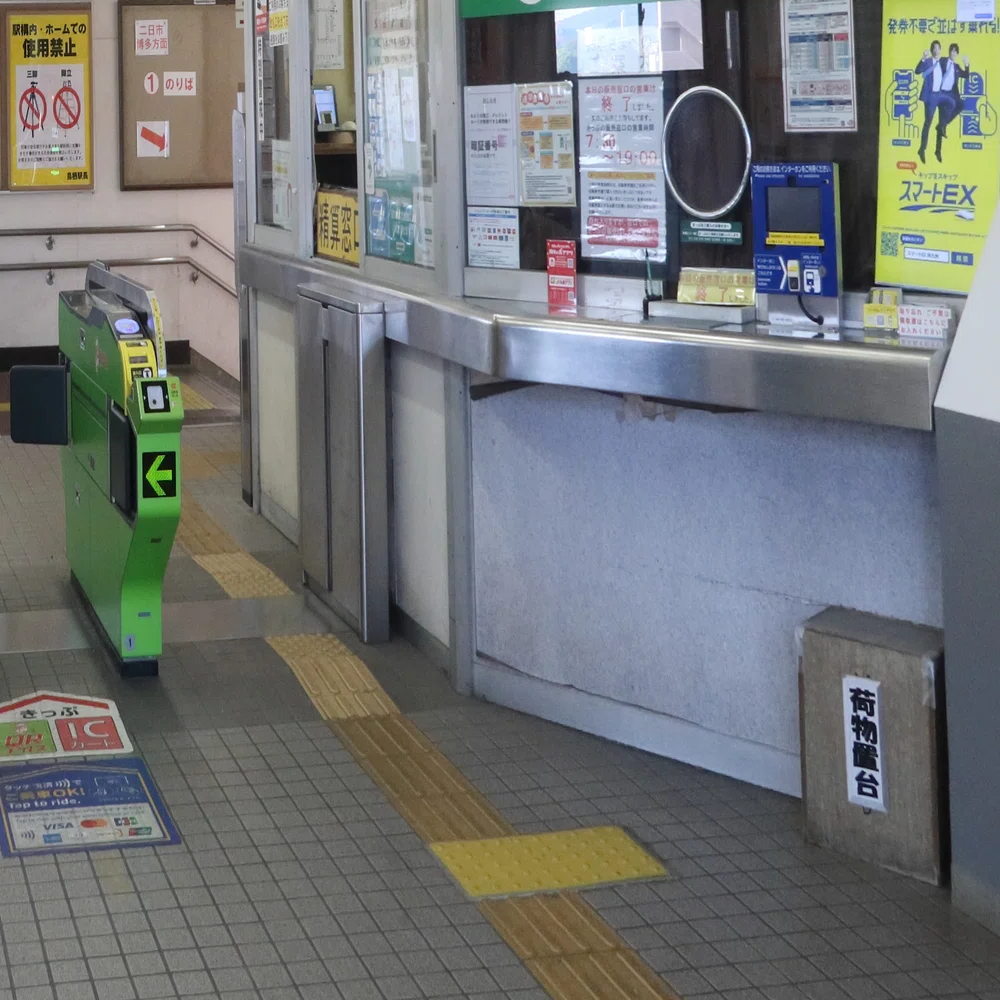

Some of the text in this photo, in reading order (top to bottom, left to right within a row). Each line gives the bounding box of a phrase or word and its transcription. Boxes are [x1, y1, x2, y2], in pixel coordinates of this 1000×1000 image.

[12, 22, 87, 36] 駅構内・ホームでの
[139, 24, 163, 36] 二日市
[22, 37, 77, 59] 使用禁止
[137, 38, 168, 50] 博多方面
[147, 74, 194, 92] 1 のりば
[471, 140, 498, 151] 暗証番号
[899, 181, 978, 206] スマートEX
[20, 706, 80, 719] きっぷ
[68, 720, 109, 739] IC
[849, 687, 880, 799] 荷物置台
[9, 802, 31, 810] Tap
[52, 798, 81, 807] ride.
[43, 822, 75, 831] VISA
